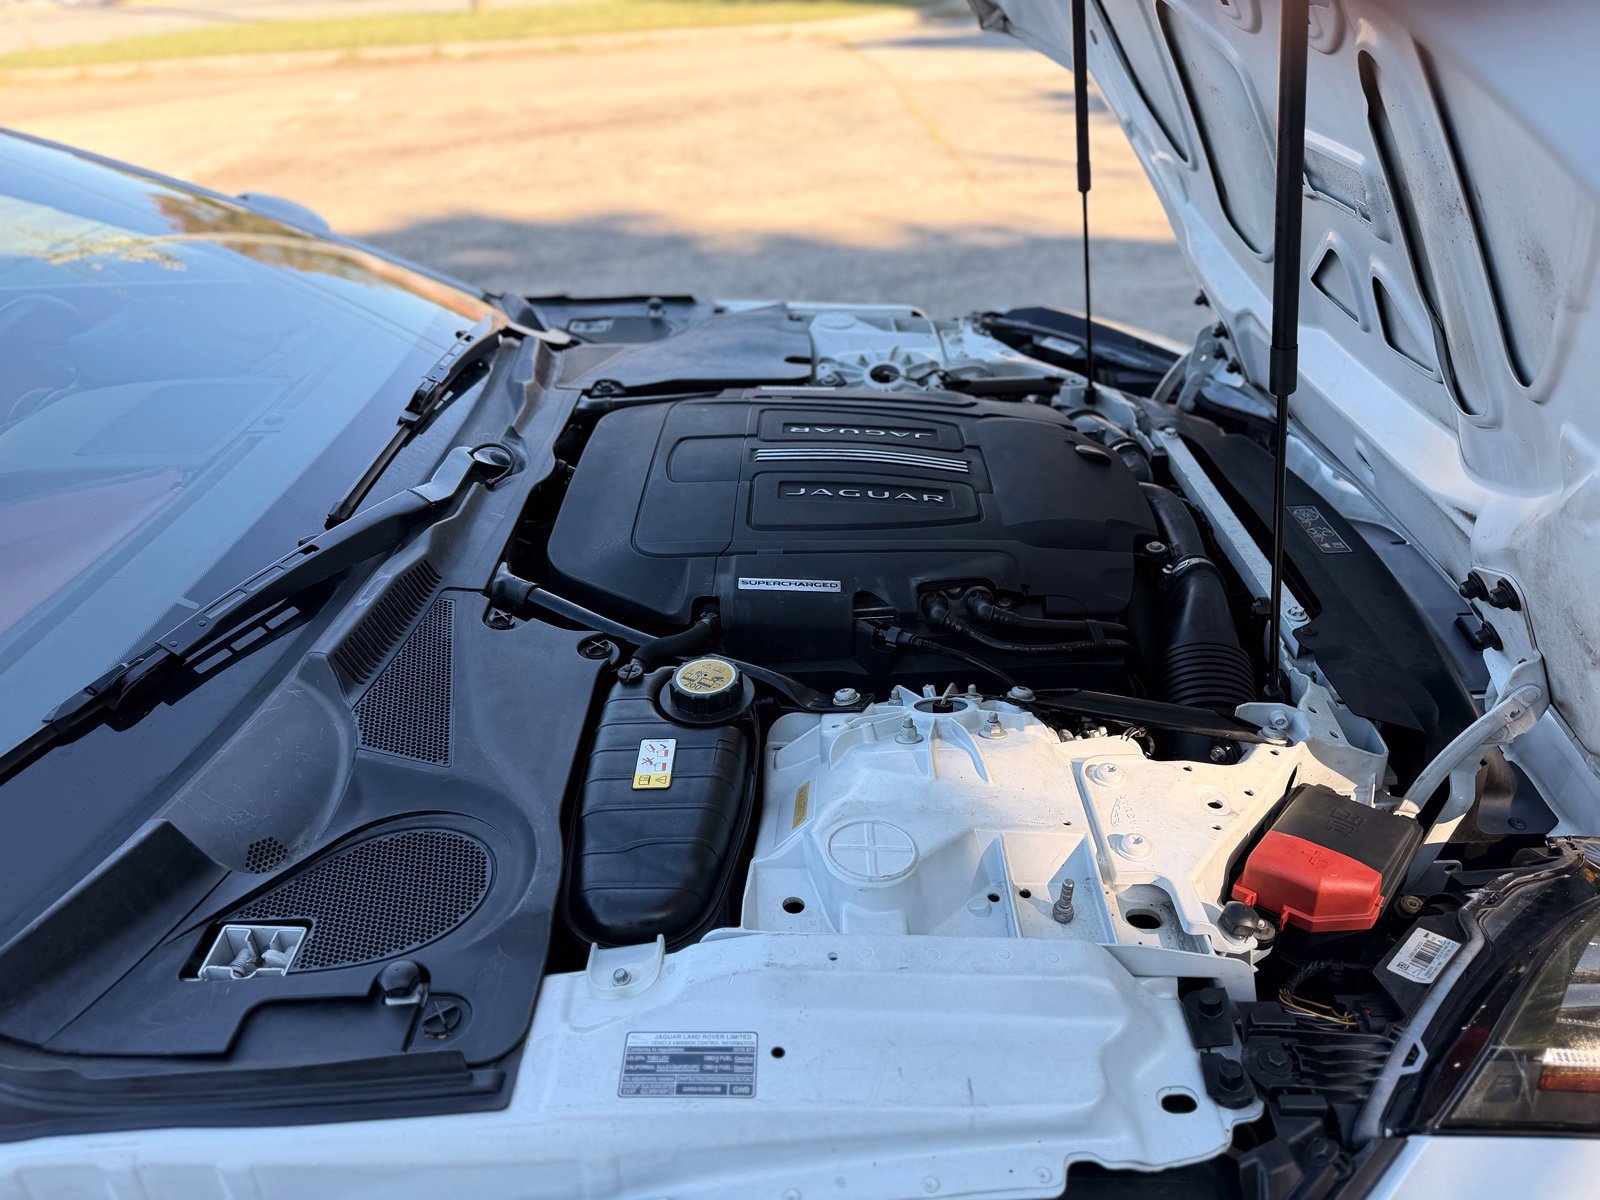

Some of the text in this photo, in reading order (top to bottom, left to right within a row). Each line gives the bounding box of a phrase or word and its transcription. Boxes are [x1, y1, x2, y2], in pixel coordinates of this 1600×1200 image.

[789, 427, 932, 438] JAGUAR
[786, 487, 944, 503] JAGUAR
[741, 580, 838, 588] SUPERCHARGED
